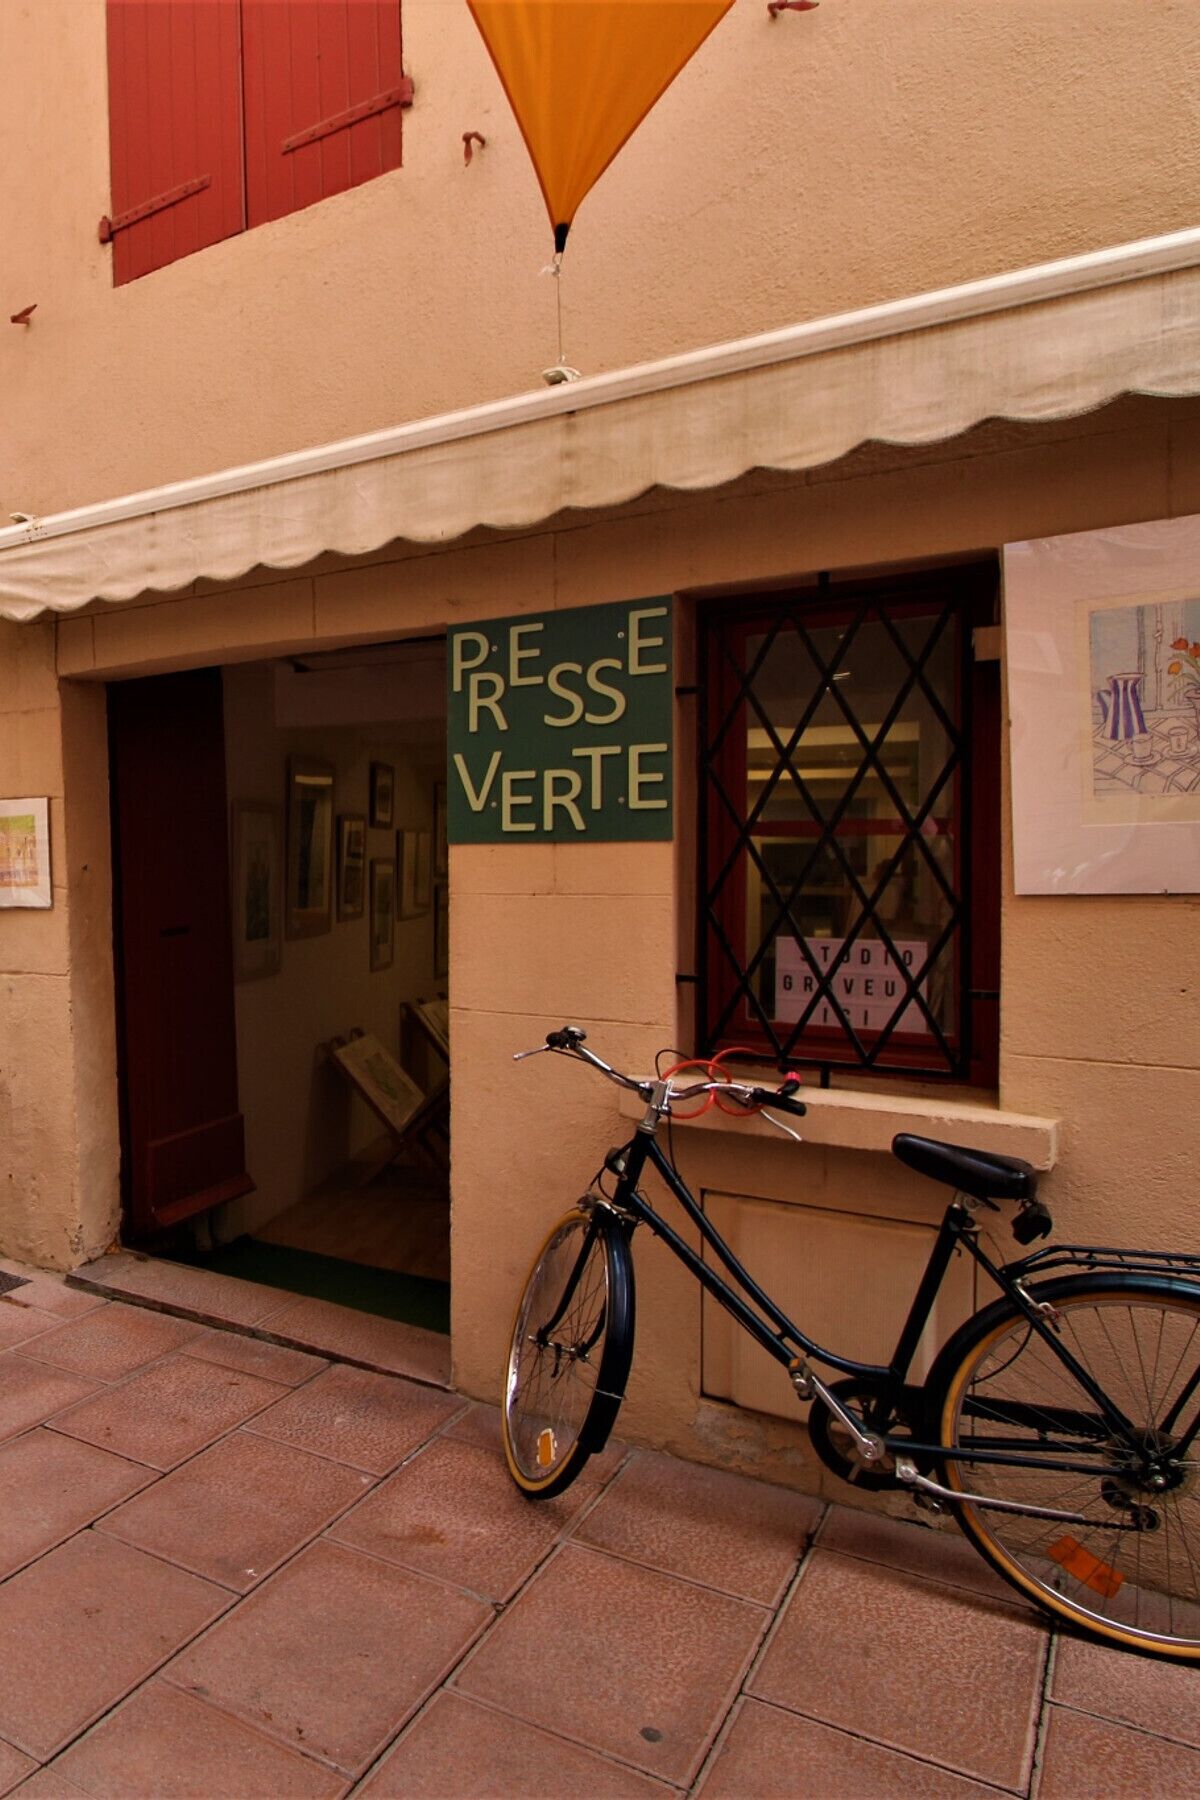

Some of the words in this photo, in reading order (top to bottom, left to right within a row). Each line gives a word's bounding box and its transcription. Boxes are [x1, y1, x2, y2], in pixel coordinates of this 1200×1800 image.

[452, 607, 668, 733] PRESSE
[453, 743, 668, 832] VERTE
[801, 946, 913, 966] TUDIO
